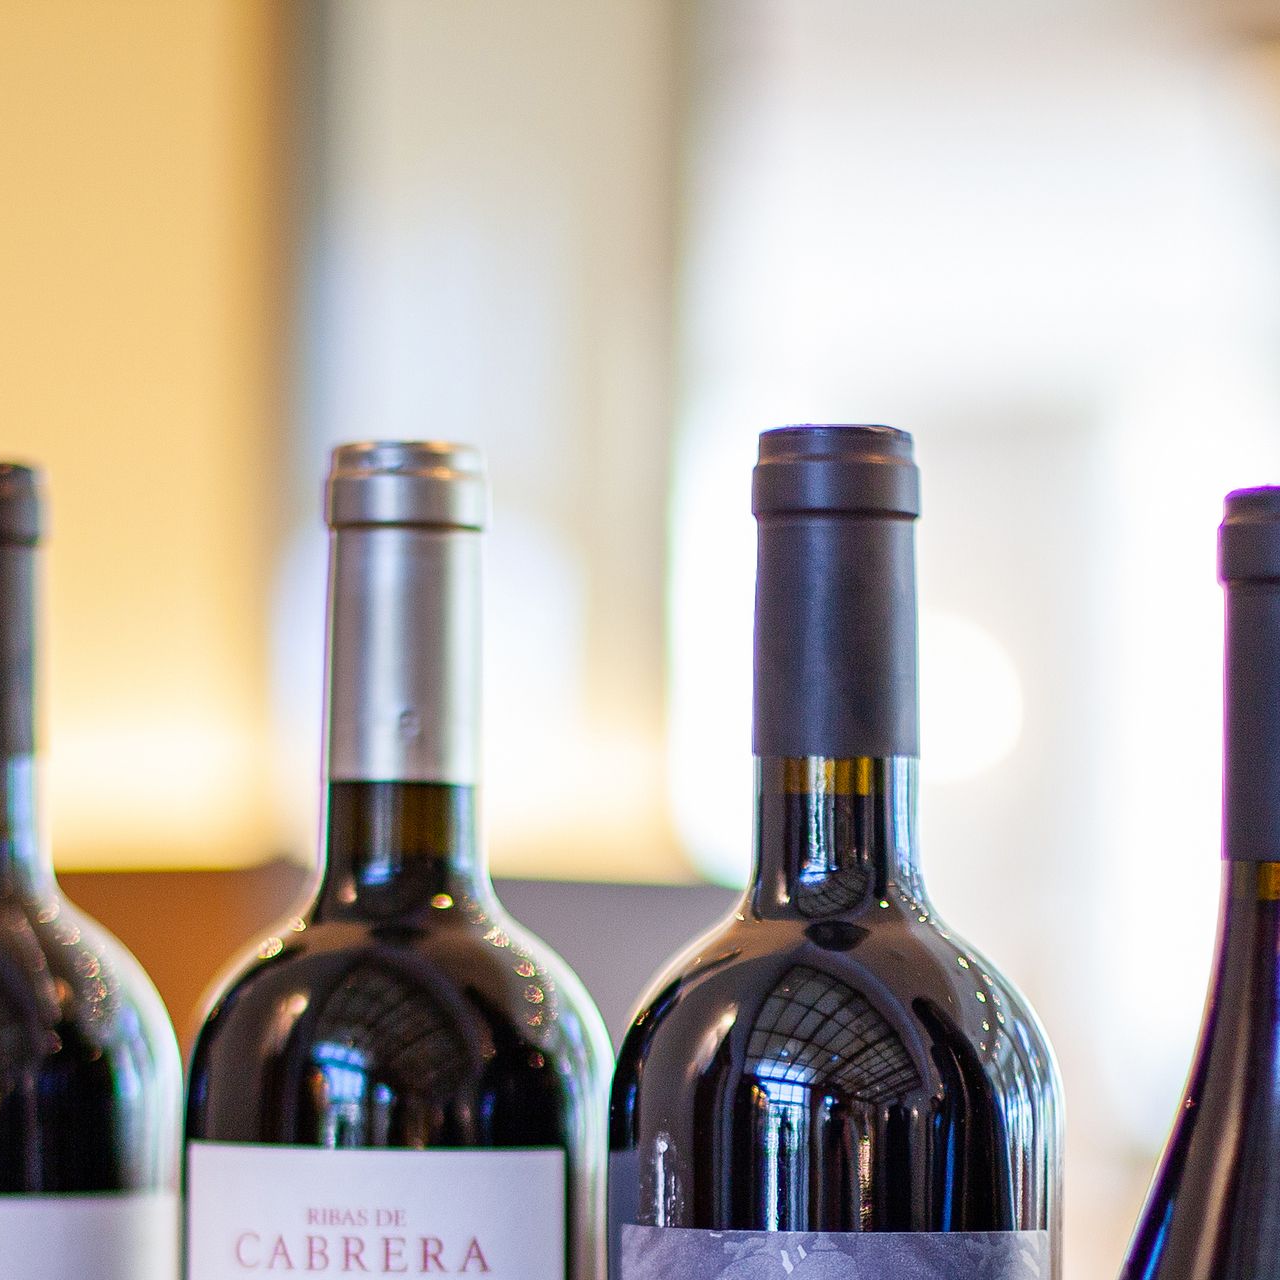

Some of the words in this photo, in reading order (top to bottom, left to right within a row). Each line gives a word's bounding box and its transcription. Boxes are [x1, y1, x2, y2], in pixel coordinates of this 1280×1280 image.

[306, 1207, 369, 1227] RIBAS
[375, 1208, 407, 1228] DE
[234, 1231, 492, 1273] CABRERA
